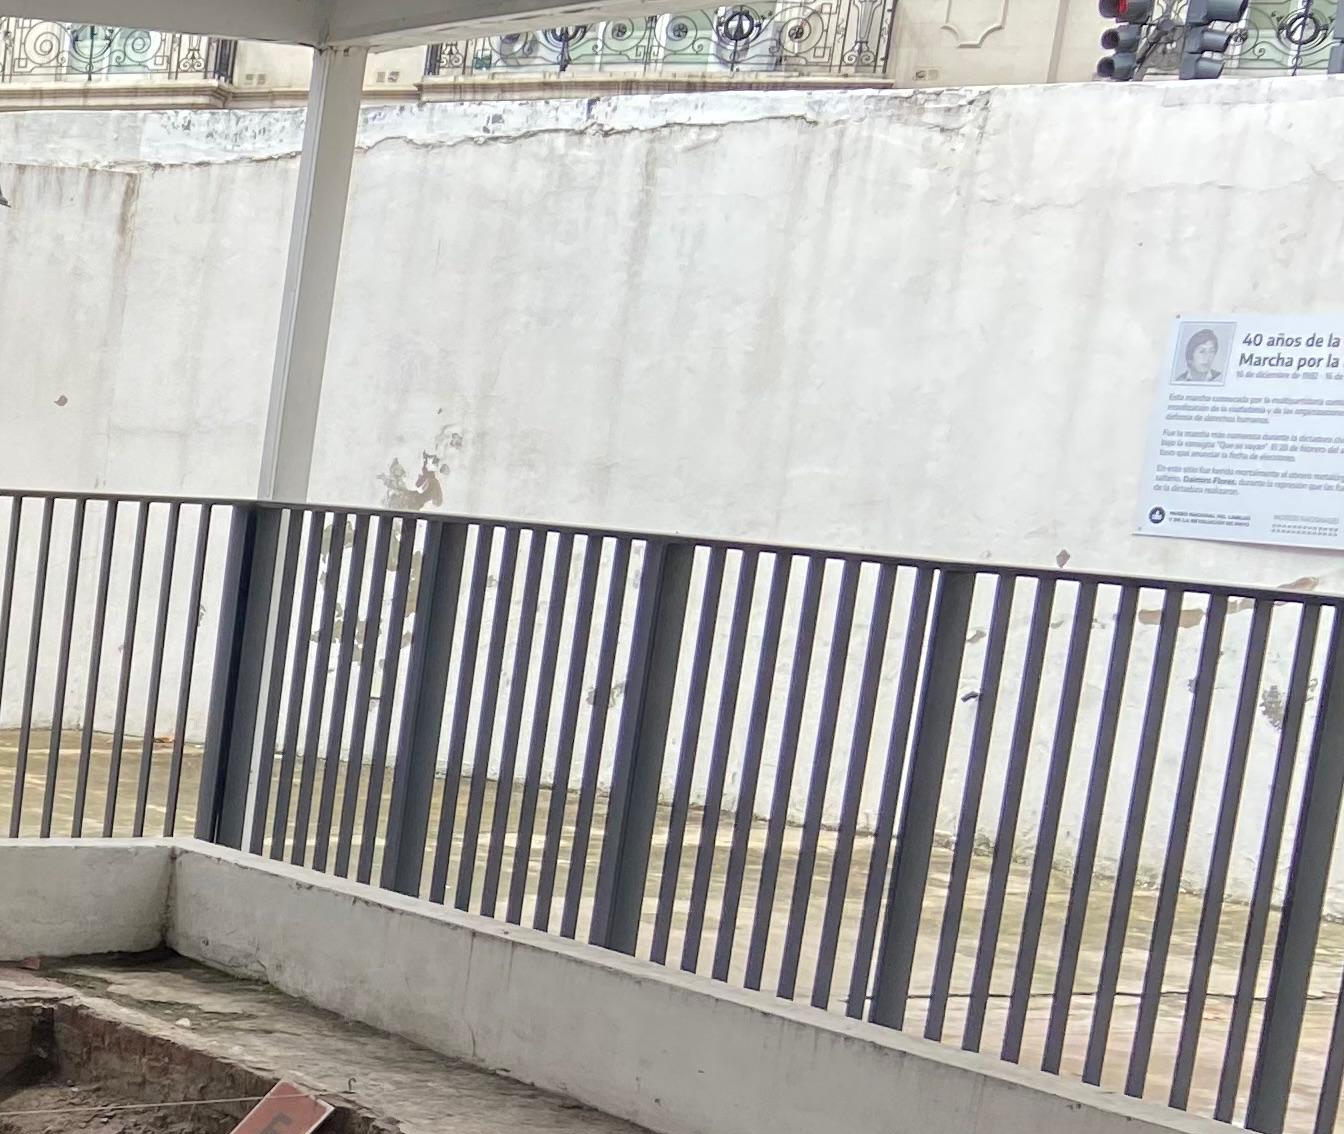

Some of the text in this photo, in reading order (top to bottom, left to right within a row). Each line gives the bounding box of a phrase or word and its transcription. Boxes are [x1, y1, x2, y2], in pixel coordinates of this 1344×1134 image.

[1242, 332, 1341, 348] 40 años de la
[1238, 352, 1340, 371] Marcha por la
